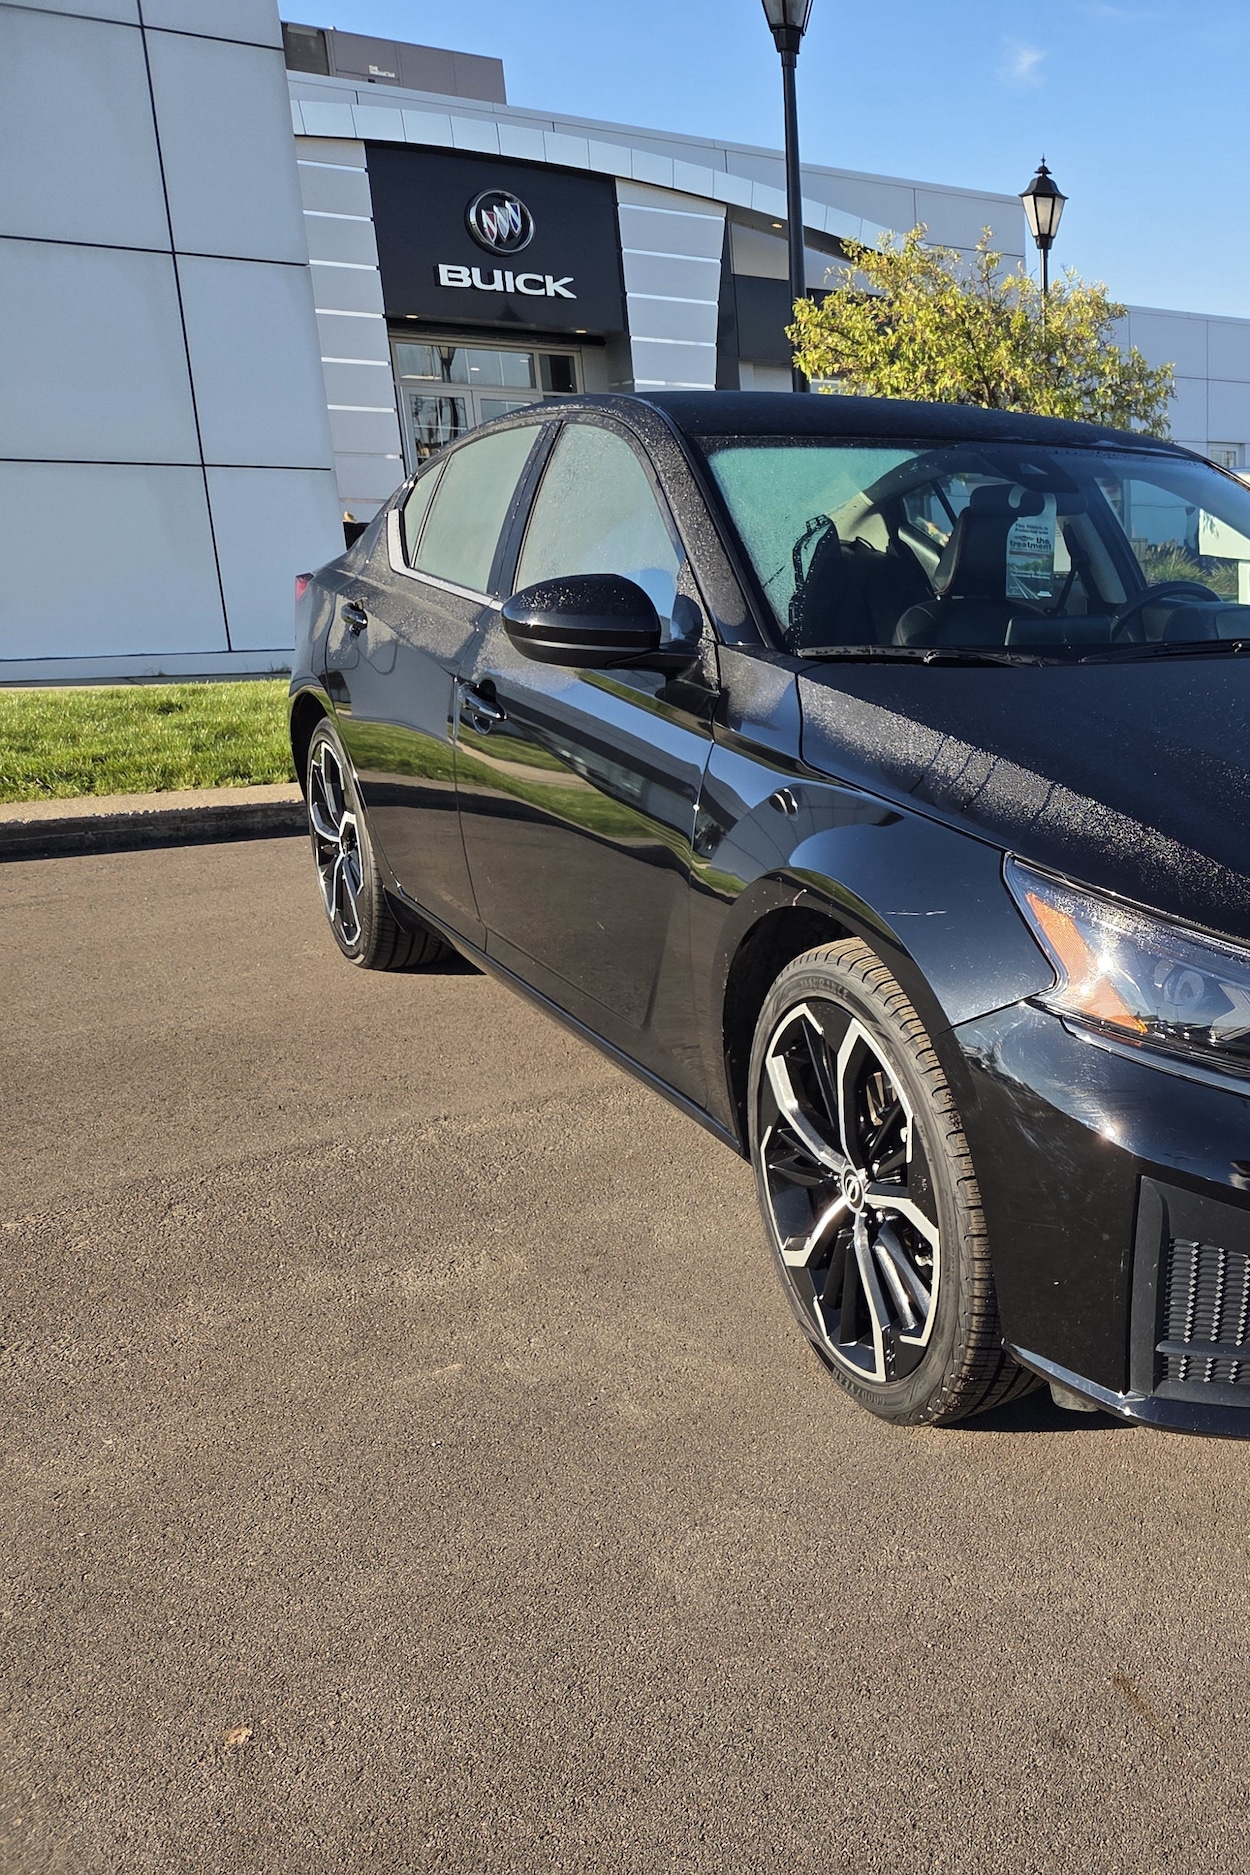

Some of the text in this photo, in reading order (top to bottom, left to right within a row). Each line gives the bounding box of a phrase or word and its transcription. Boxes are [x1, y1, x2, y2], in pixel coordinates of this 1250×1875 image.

[437, 263, 577, 299] BUICK
[1010, 540, 1052, 550] treatment
[799, 977, 849, 1000] ASSURANCE
[832, 1366, 886, 1407] GOODYEAR
